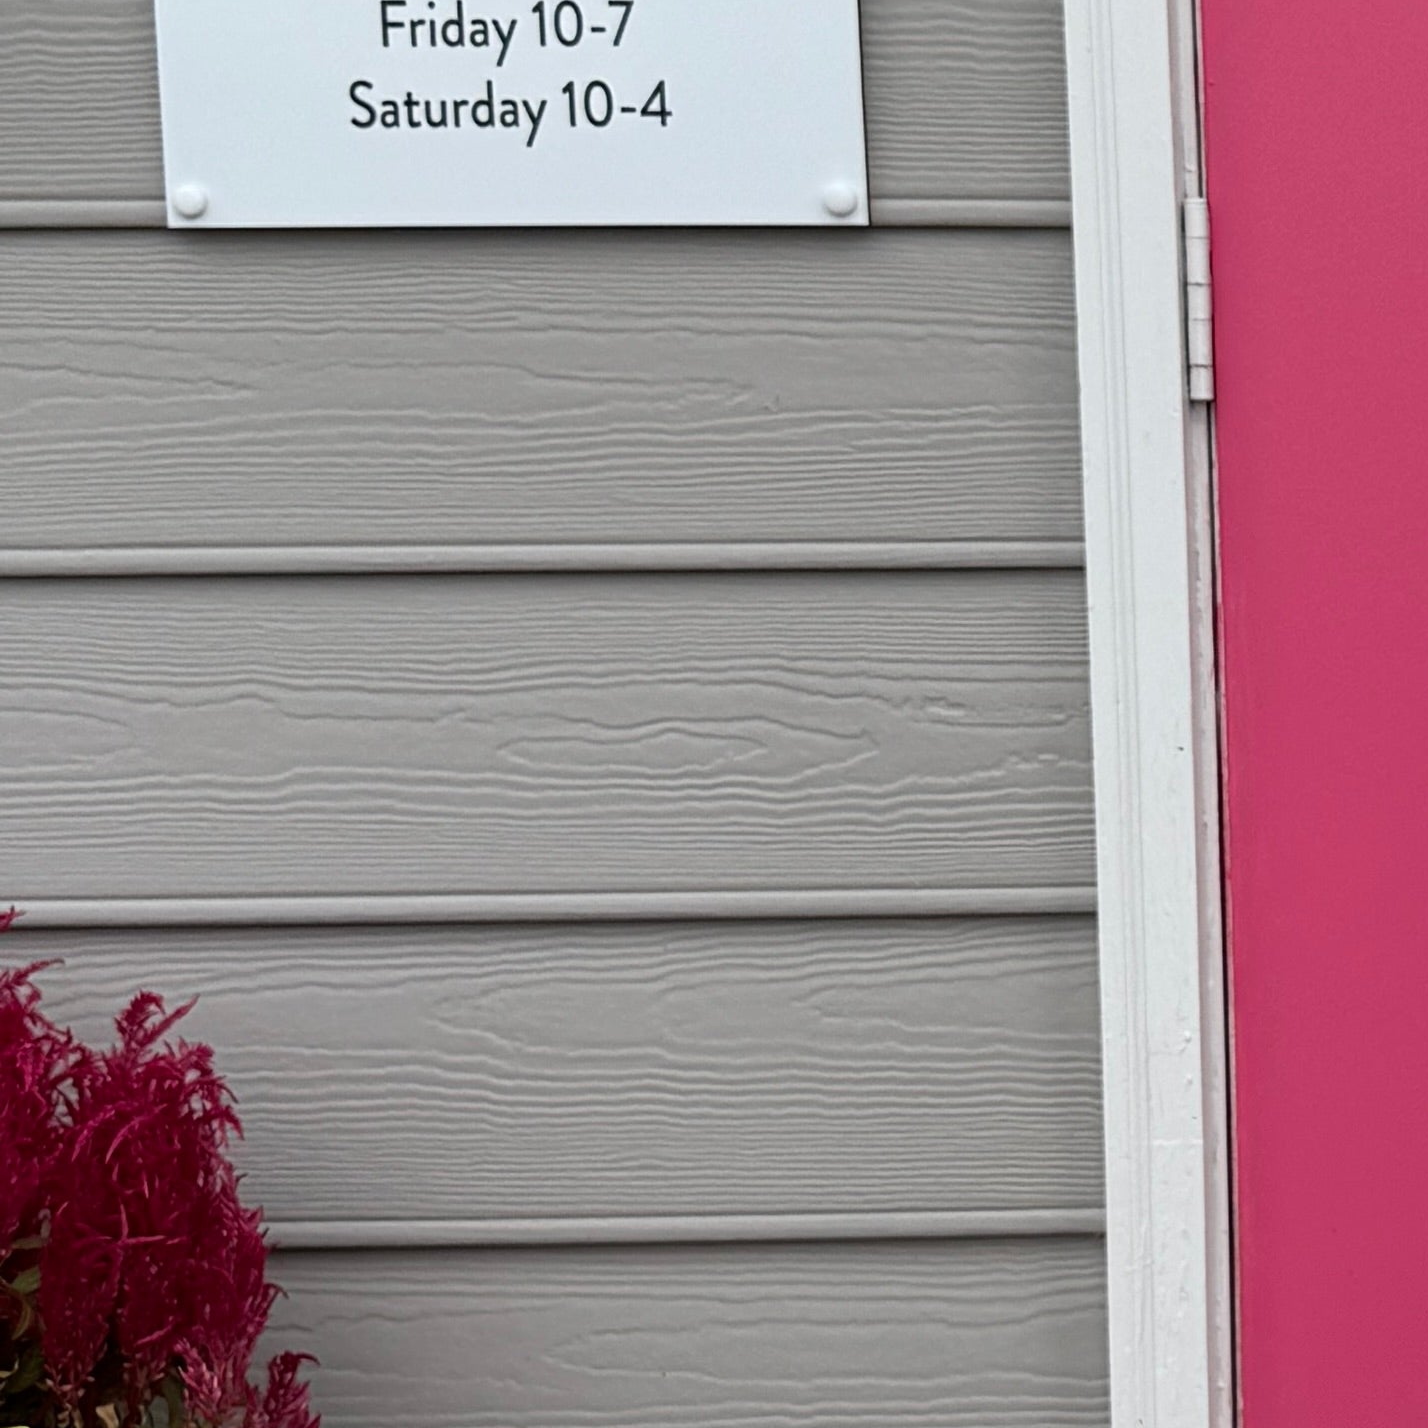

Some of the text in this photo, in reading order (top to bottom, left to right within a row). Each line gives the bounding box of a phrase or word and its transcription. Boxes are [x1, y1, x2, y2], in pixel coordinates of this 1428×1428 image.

[380, 0, 634, 68] Friday 10-7
[349, 79, 673, 148] Saturday 10-4
